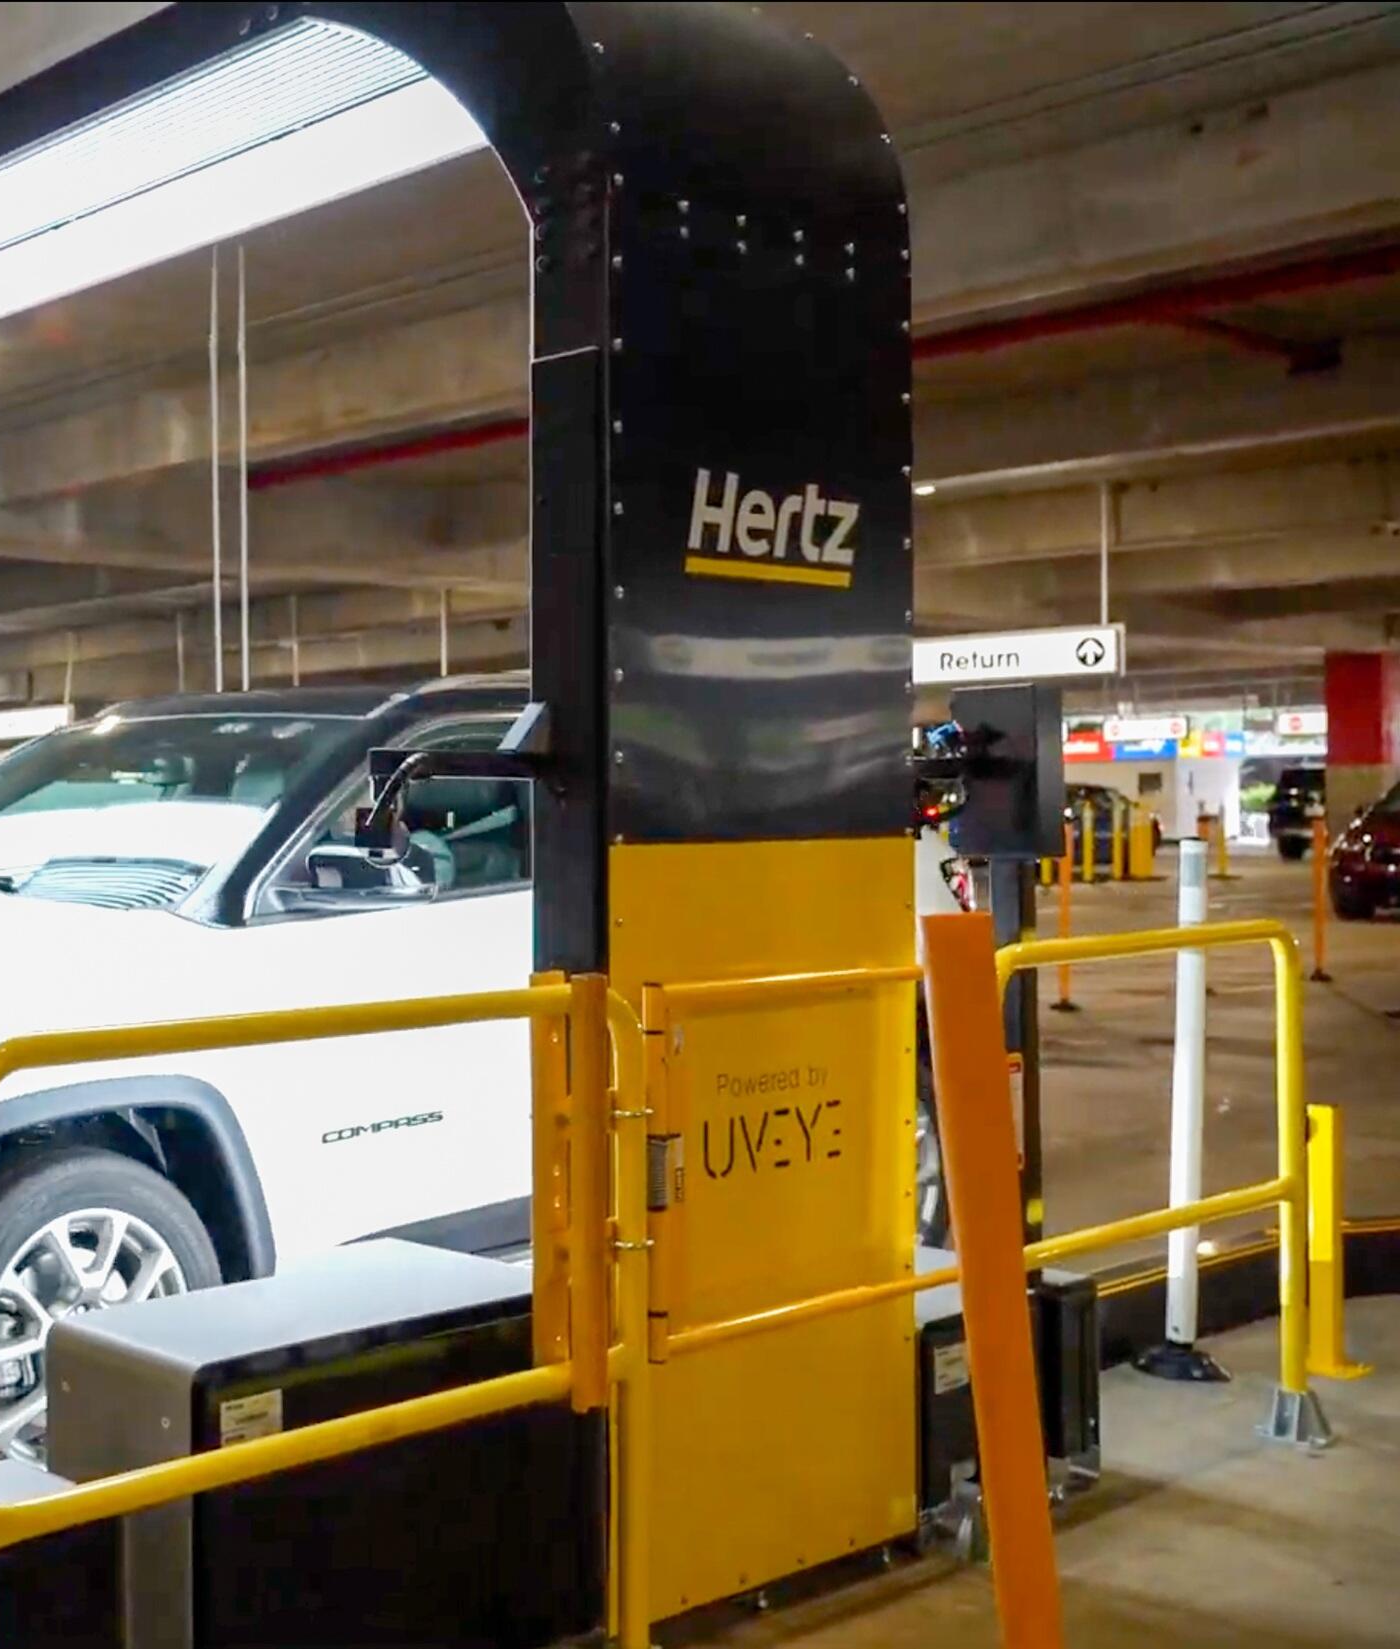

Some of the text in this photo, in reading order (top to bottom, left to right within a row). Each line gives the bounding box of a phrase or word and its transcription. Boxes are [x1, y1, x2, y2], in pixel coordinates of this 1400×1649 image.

[687, 467, 860, 565] Hertz
[939, 651, 1020, 671] Return
[716, 1065, 829, 1097] Powered by
[322, 1110, 443, 1144] COMPASS
[703, 1099, 841, 1180] UVEYE
